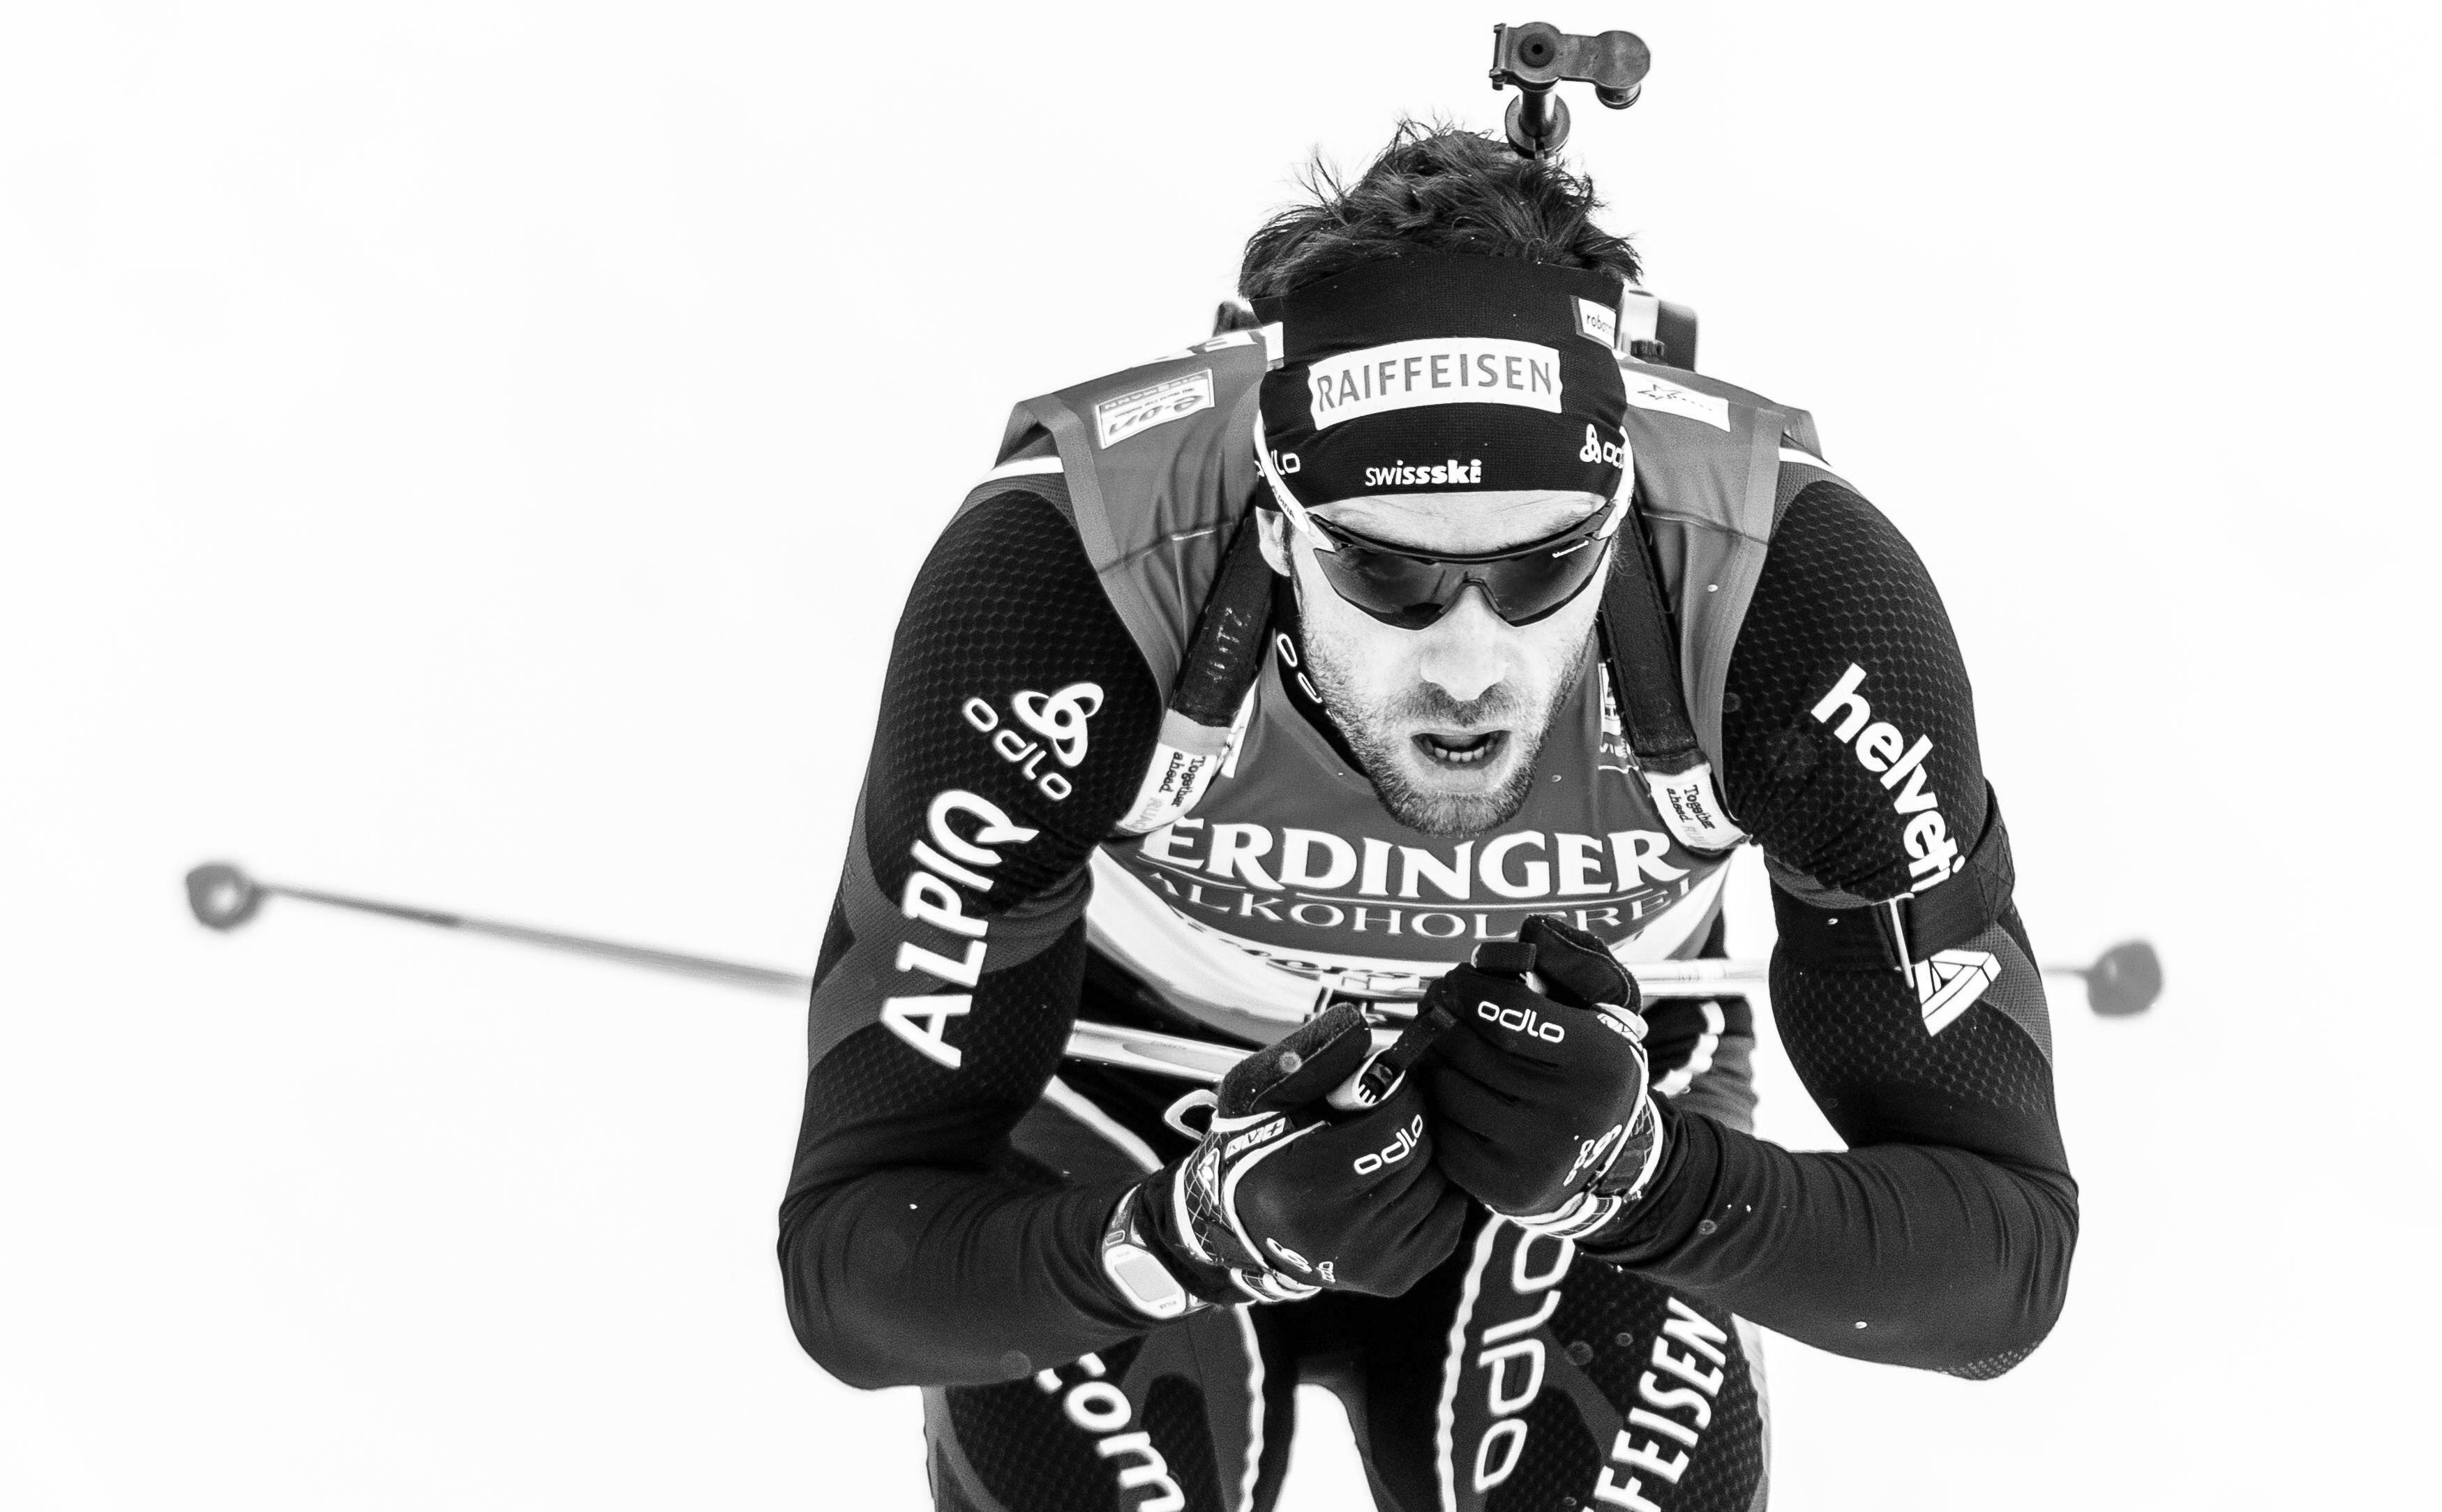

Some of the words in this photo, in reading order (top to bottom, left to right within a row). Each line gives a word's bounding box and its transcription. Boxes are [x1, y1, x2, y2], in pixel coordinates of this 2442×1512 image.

[1317, 352, 1553, 412] RAIFFEISEN
[1365, 458, 1482, 486] swissski
[961, 696, 1072, 801] odlo
[1139, 818, 1691, 900] ERDINGER
[881, 788, 1040, 1070] ALPIQ
[1150, 871, 1690, 940] ALKOHOLREI
[1478, 1001, 1565, 1043] odlo
[1354, 1114, 1423, 1175] odlo
[1474, 1228, 1575, 1494] odlo
[1580, 1296, 1728, 1512] FEISEN
